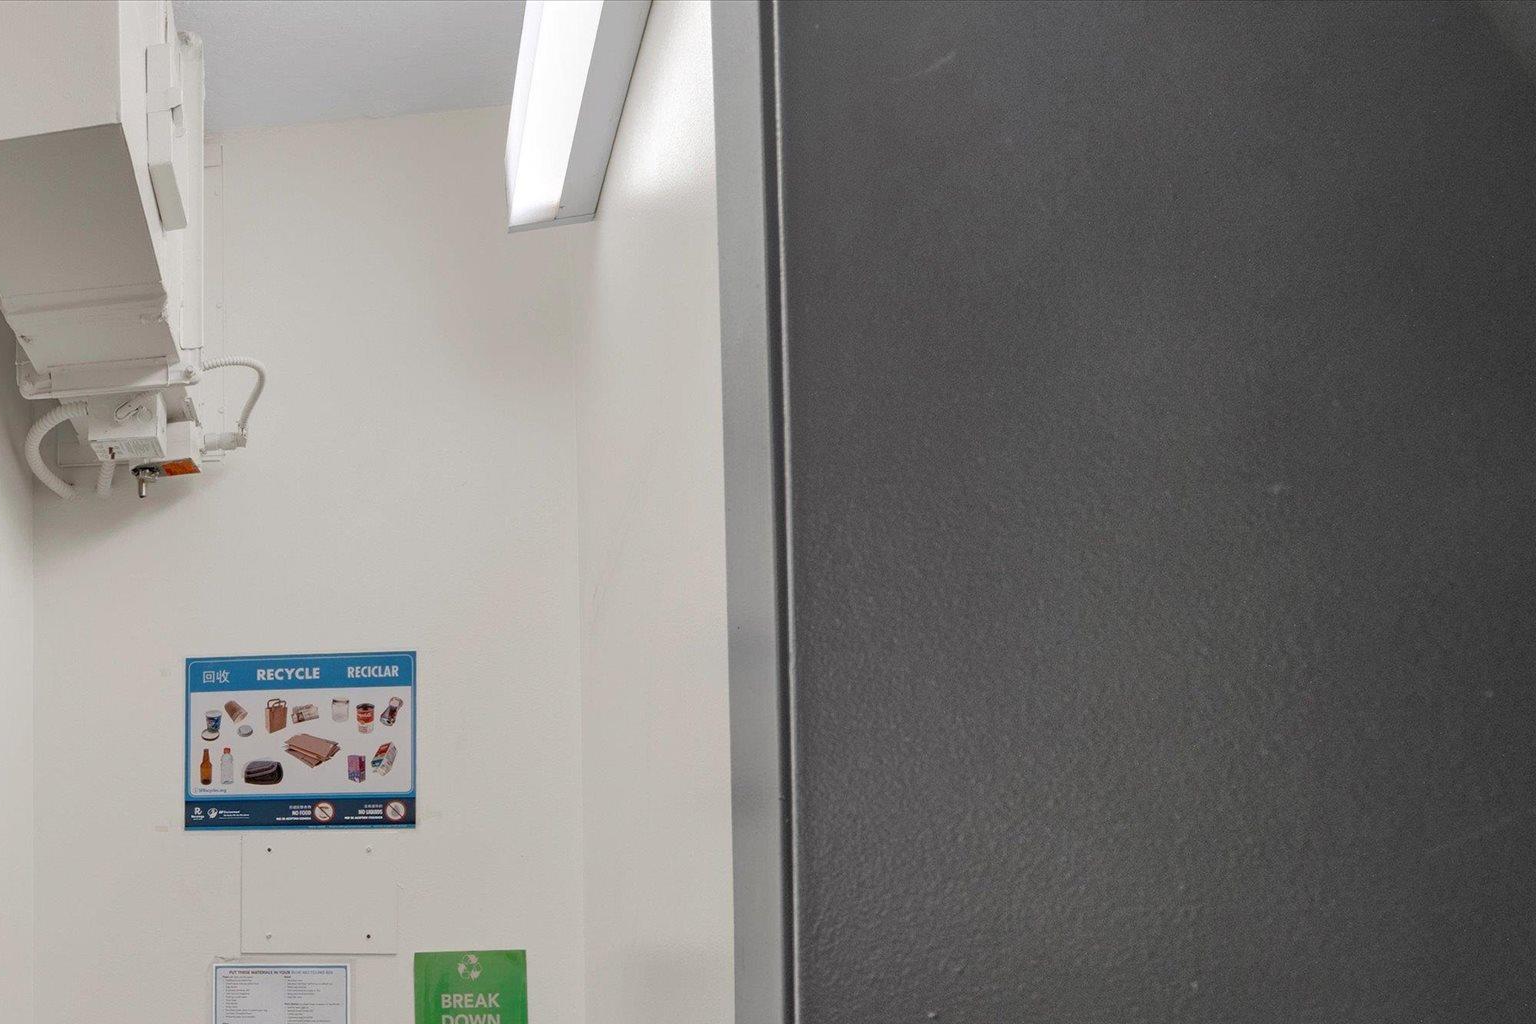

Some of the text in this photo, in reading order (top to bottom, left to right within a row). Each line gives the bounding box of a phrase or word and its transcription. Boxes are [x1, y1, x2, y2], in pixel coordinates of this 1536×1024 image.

[202, 670, 230, 684] 回收
[256, 665, 399, 681] RECYCLE RECICLAR
[441, 993, 500, 1009] BREAK
